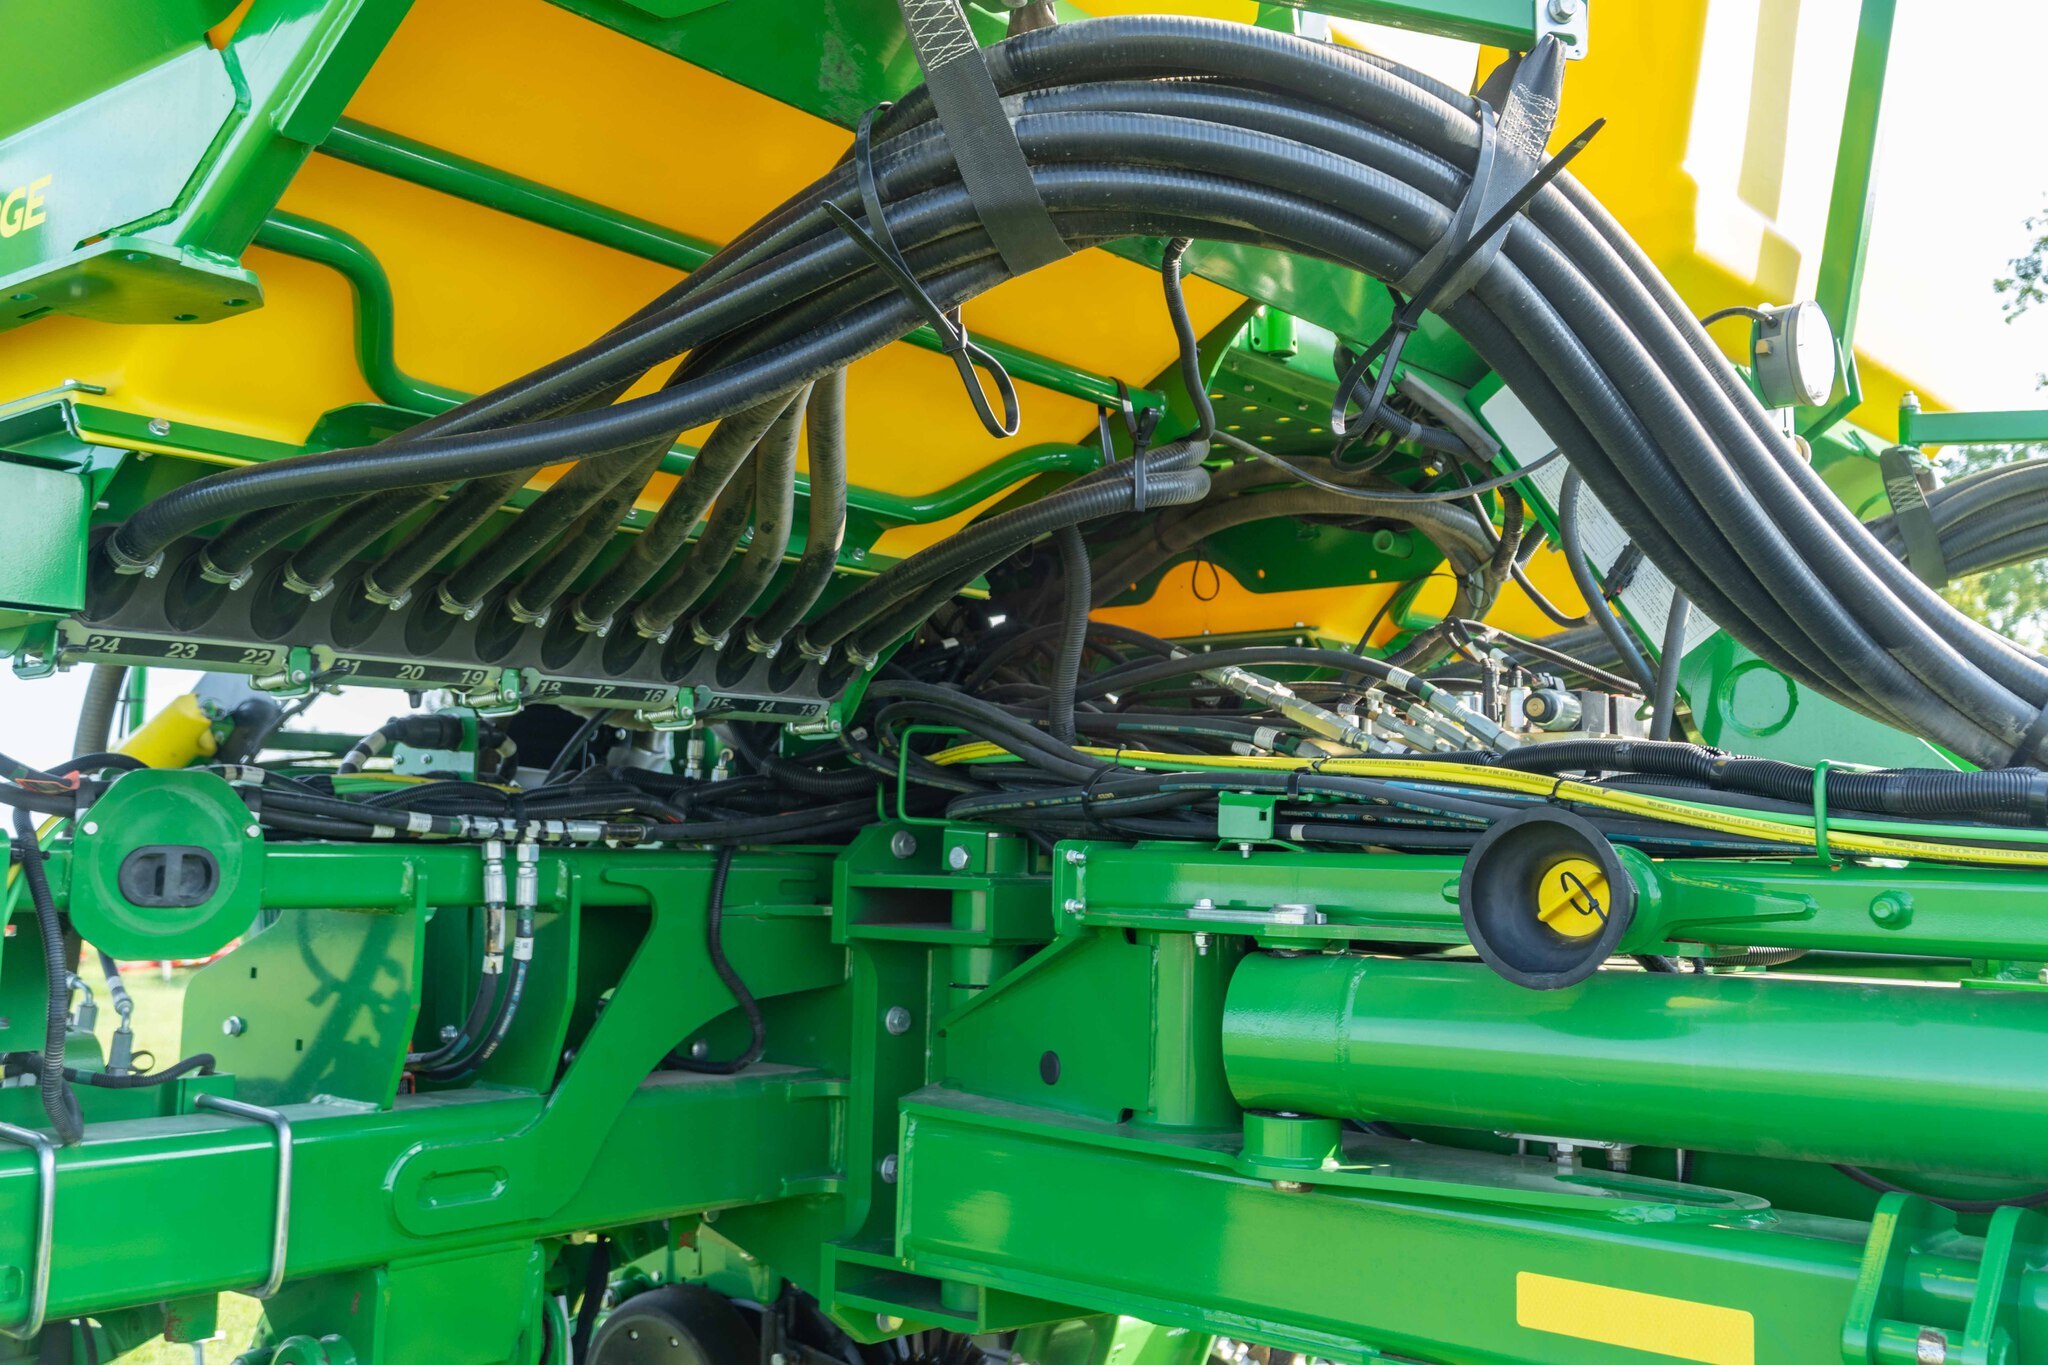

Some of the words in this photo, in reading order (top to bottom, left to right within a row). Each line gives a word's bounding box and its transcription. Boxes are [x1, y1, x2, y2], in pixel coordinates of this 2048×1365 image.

[88, 636, 121, 653] 24
[165, 642, 199, 659] 23
[239, 648, 272, 665] 22
[396, 664, 425, 680] 20
[459, 669, 485, 686] 19
[540, 680, 561, 693] 18
[592, 685, 616, 699] 17
[643, 689, 665, 703] 16
[756, 701, 774, 713] 14
[801, 703, 819, 716] 13
